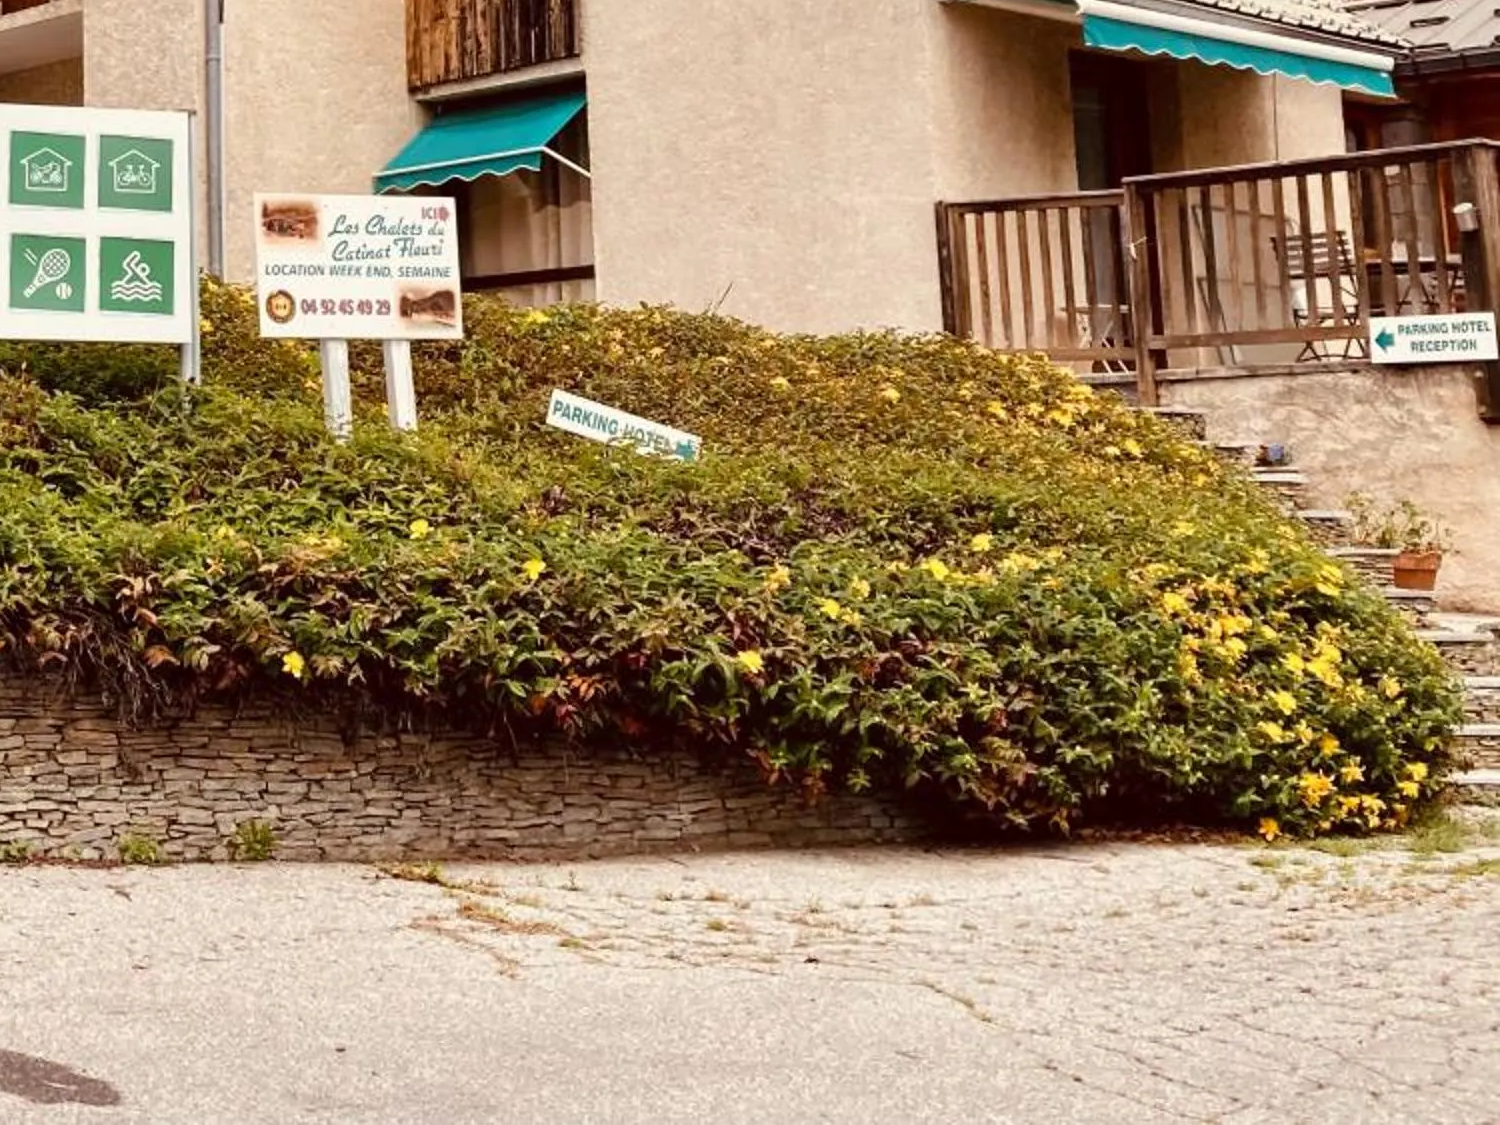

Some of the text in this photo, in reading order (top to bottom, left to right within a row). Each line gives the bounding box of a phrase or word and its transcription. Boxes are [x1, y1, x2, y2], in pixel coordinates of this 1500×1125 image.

[327, 214, 445, 237] Les Chalets du
[331, 236, 444, 262] Catinat Fleuri
[264, 263, 325, 277] LOCATION
[329, 264, 364, 277] WEEK
[397, 265, 452, 278] SEMAINE
[300, 298, 318, 316] 04
[1397, 320, 1492, 335] PARKING HOTEL
[1410, 339, 1478, 353] RECEPTION
[552, 399, 619, 436] PARKING
